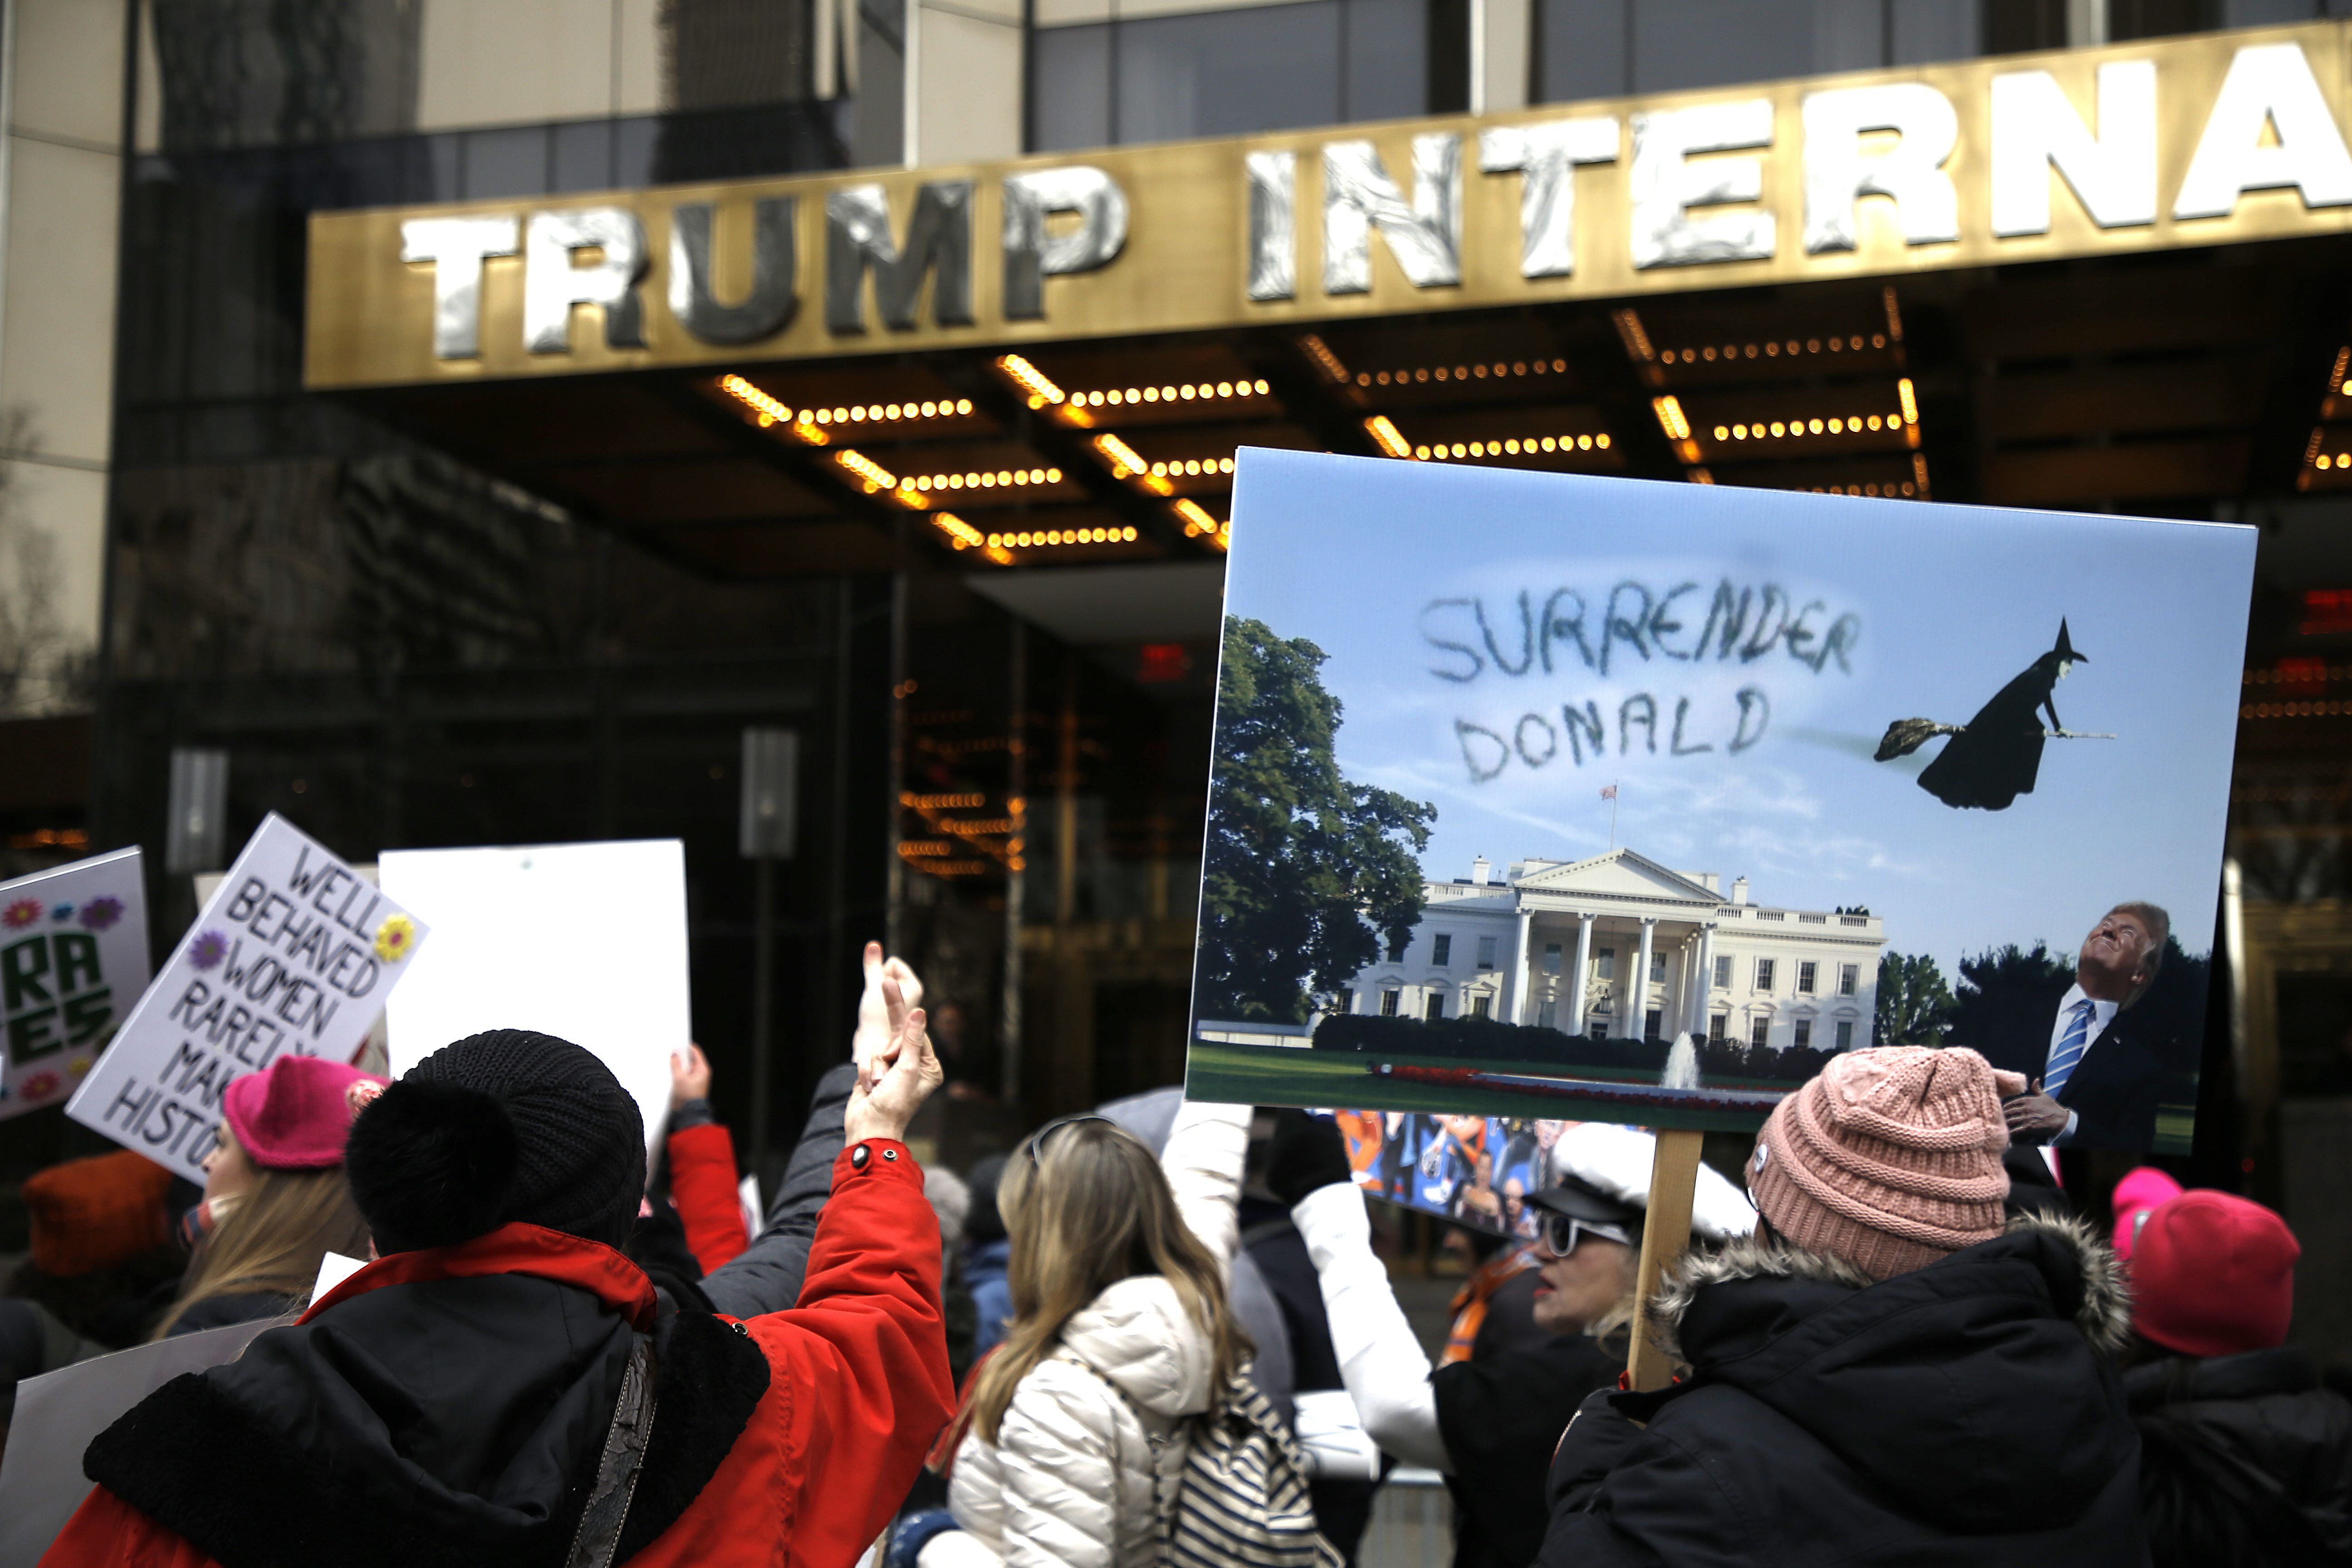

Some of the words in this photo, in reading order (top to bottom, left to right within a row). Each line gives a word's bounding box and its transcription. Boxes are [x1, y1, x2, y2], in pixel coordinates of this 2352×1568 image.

[400, 166, 1125, 362] TRUMP
[1245, 42, 2352, 302] INTERNA
[1418, 577, 1862, 683] SURRENDER
[1453, 685, 1770, 783] DONALD
[226, 877, 379, 999] BEHAVED
[289, 846, 380, 942] WELL
[223, 937, 340, 1039] WOMEN
